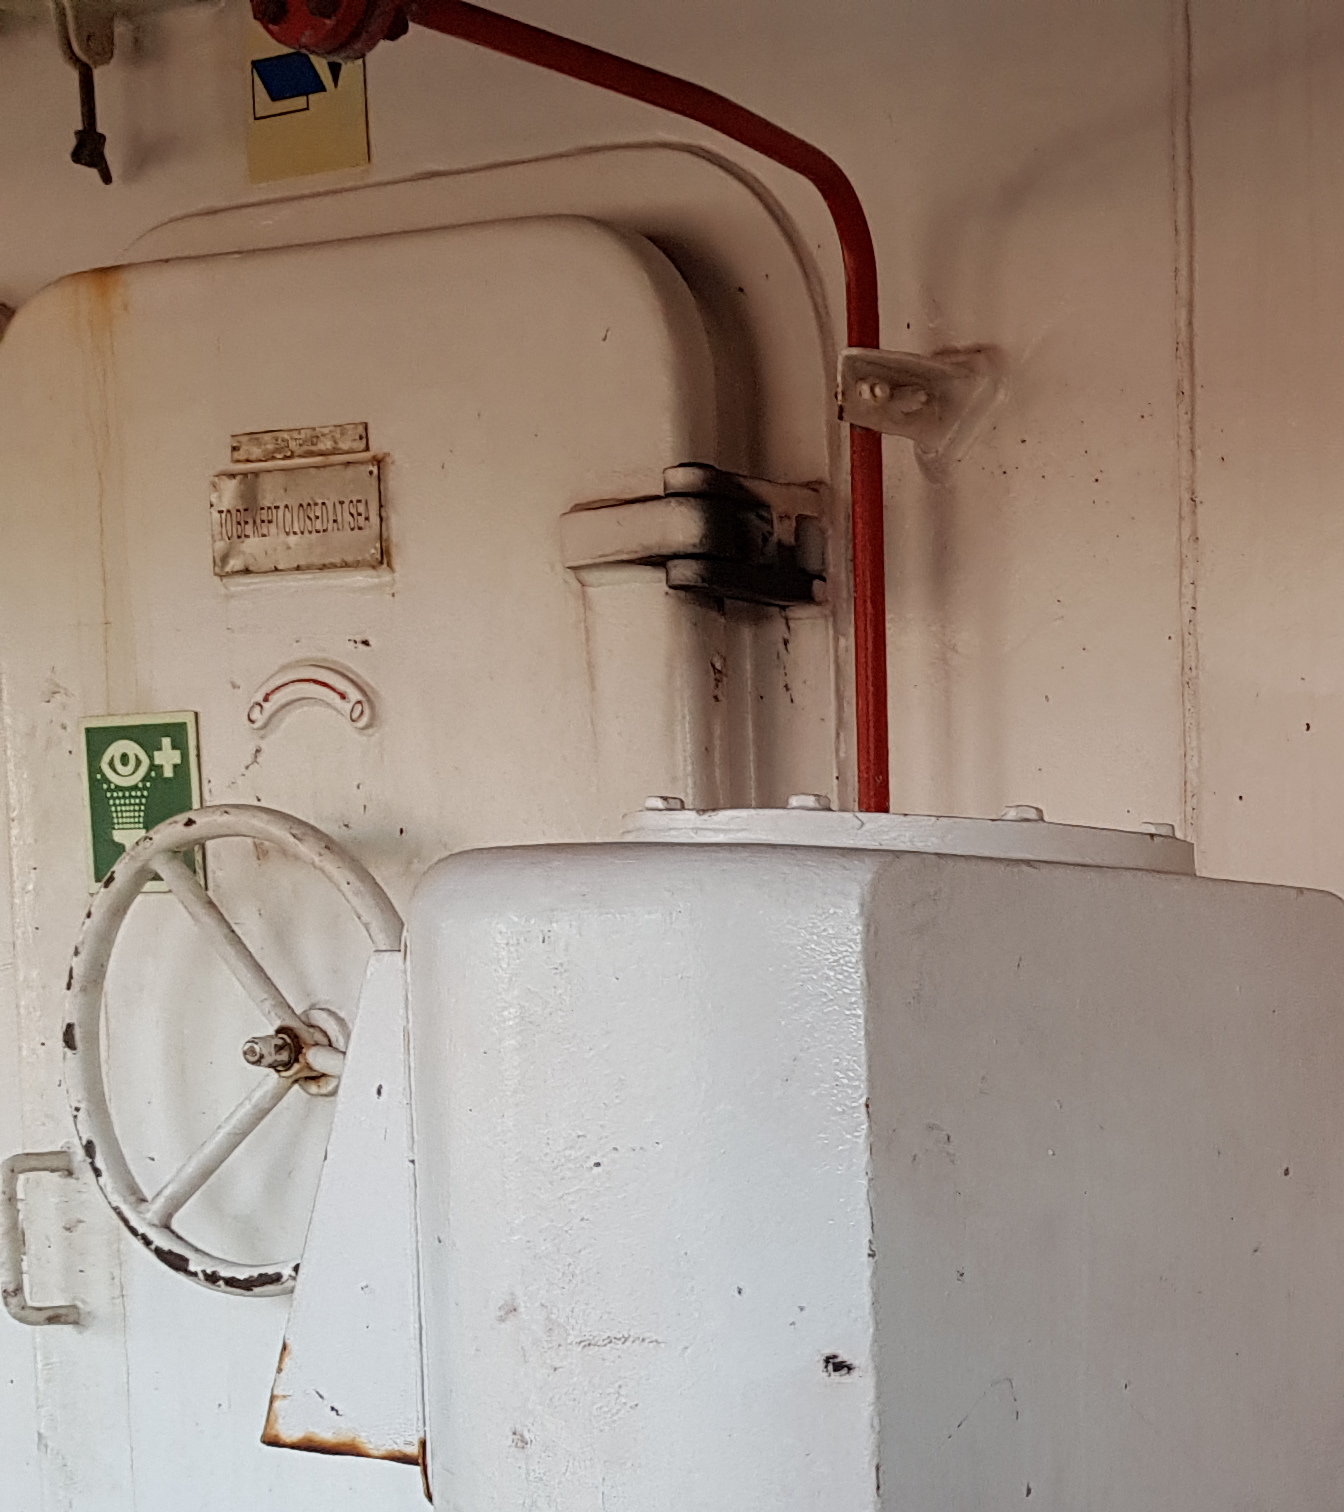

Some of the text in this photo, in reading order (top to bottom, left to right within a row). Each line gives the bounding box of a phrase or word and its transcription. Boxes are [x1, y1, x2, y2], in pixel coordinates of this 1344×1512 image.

[217, 498, 371, 541] TO BE KEPT CLOSED AT SEA
